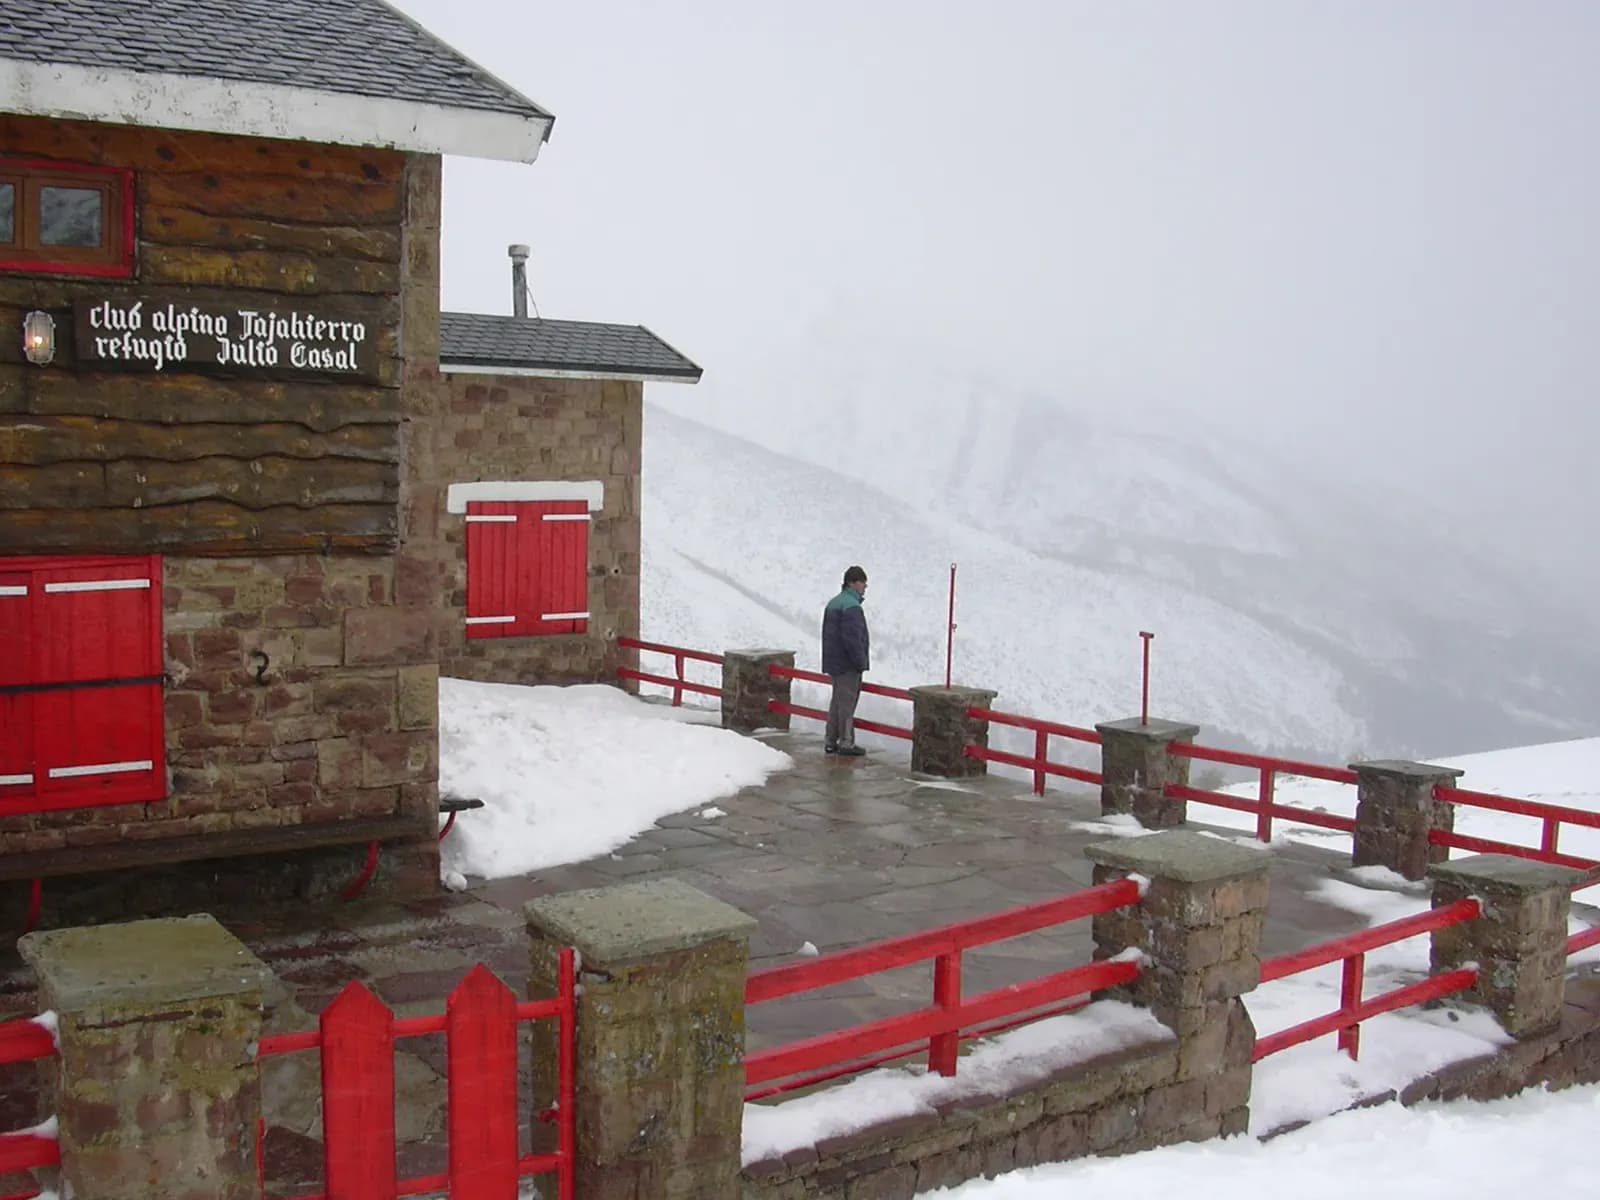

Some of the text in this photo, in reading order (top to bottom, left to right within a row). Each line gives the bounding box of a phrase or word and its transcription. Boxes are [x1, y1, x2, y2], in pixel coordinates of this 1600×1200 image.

[89, 301, 366, 345] club alpino Tajahierro
[95, 332, 359, 371] refugio Julio Casal
